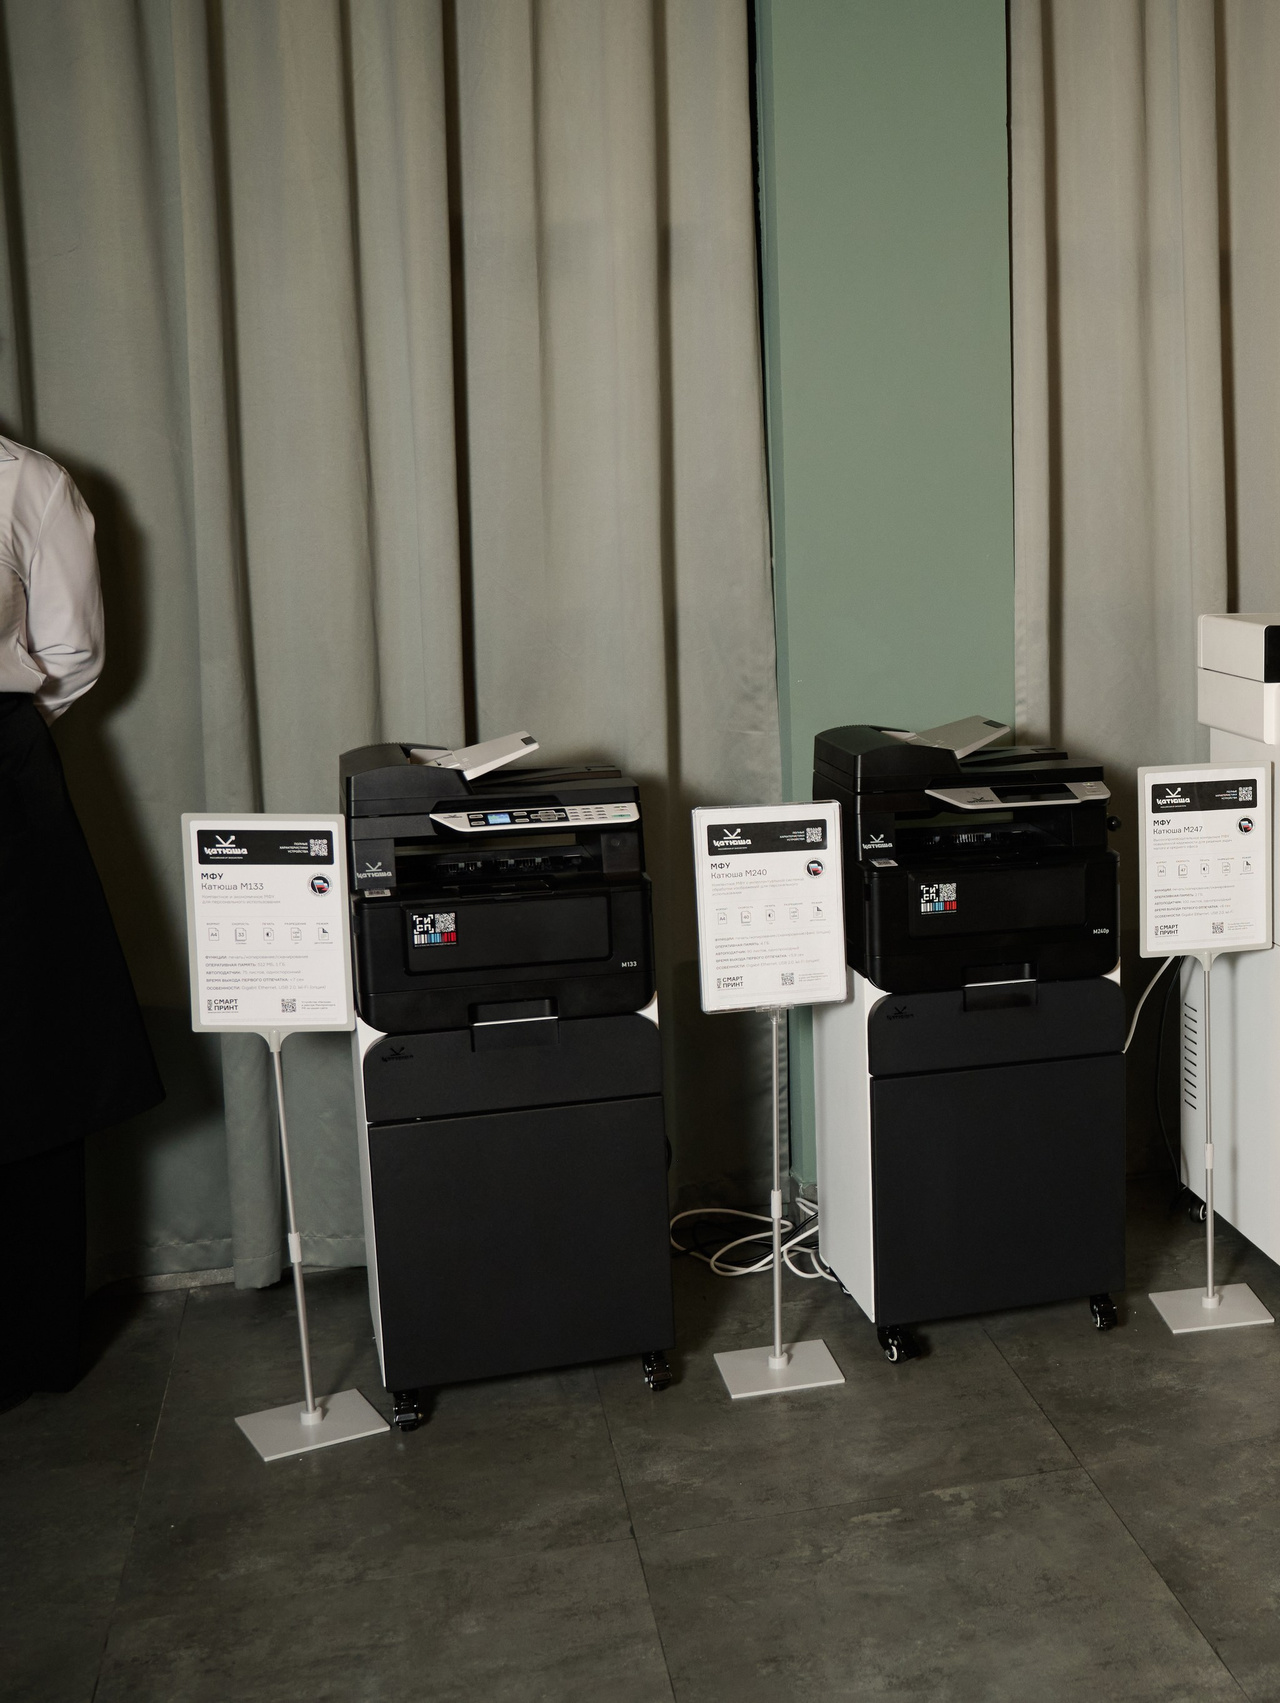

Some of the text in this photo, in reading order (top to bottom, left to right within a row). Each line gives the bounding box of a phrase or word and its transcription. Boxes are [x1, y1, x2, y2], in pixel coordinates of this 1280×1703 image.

[710, 862, 731, 870] МФУ
[201, 872, 224, 880] МФУ
[711, 871, 743, 880] Катюша
[201, 883, 238, 891] Катюша
